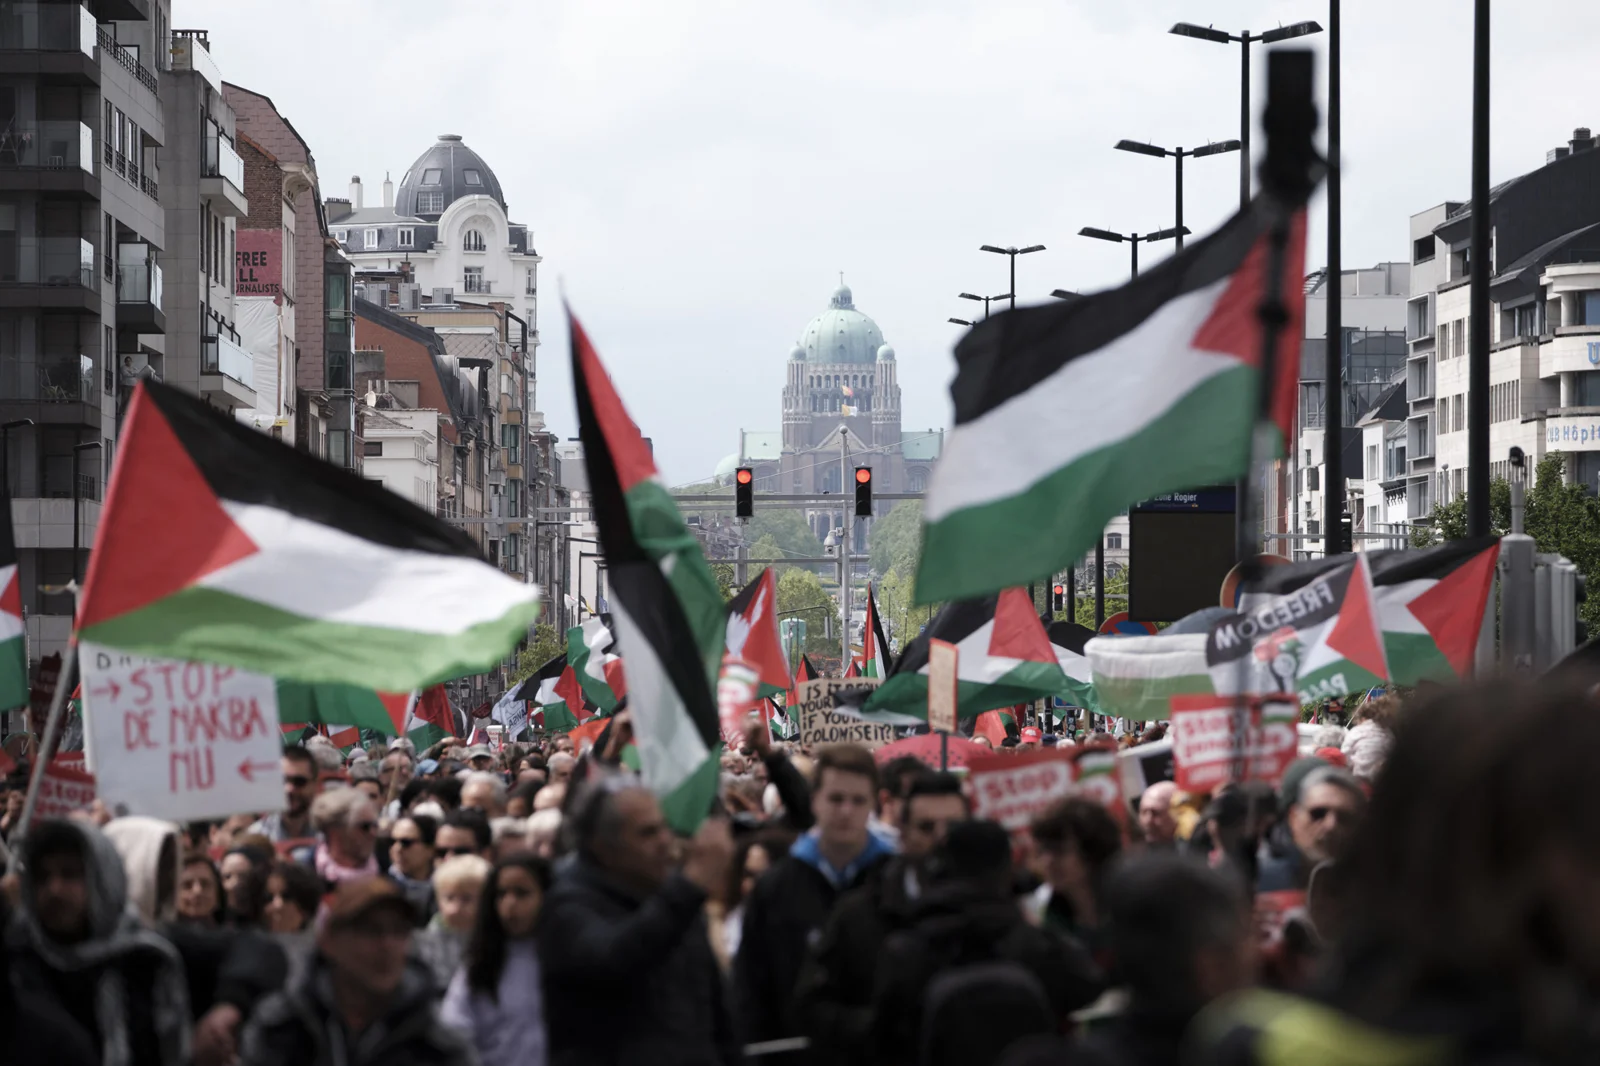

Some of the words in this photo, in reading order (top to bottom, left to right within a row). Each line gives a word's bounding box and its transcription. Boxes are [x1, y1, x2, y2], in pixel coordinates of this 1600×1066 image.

[236, 251, 267, 266] FREE
[236, 268, 258, 282] LL
[1174, 493, 1197, 503] Rogier
[130, 661, 236, 705] STOP
[800, 696, 832, 714] YOUR
[123, 709, 160, 750] DE
[169, 747, 215, 793] NU
